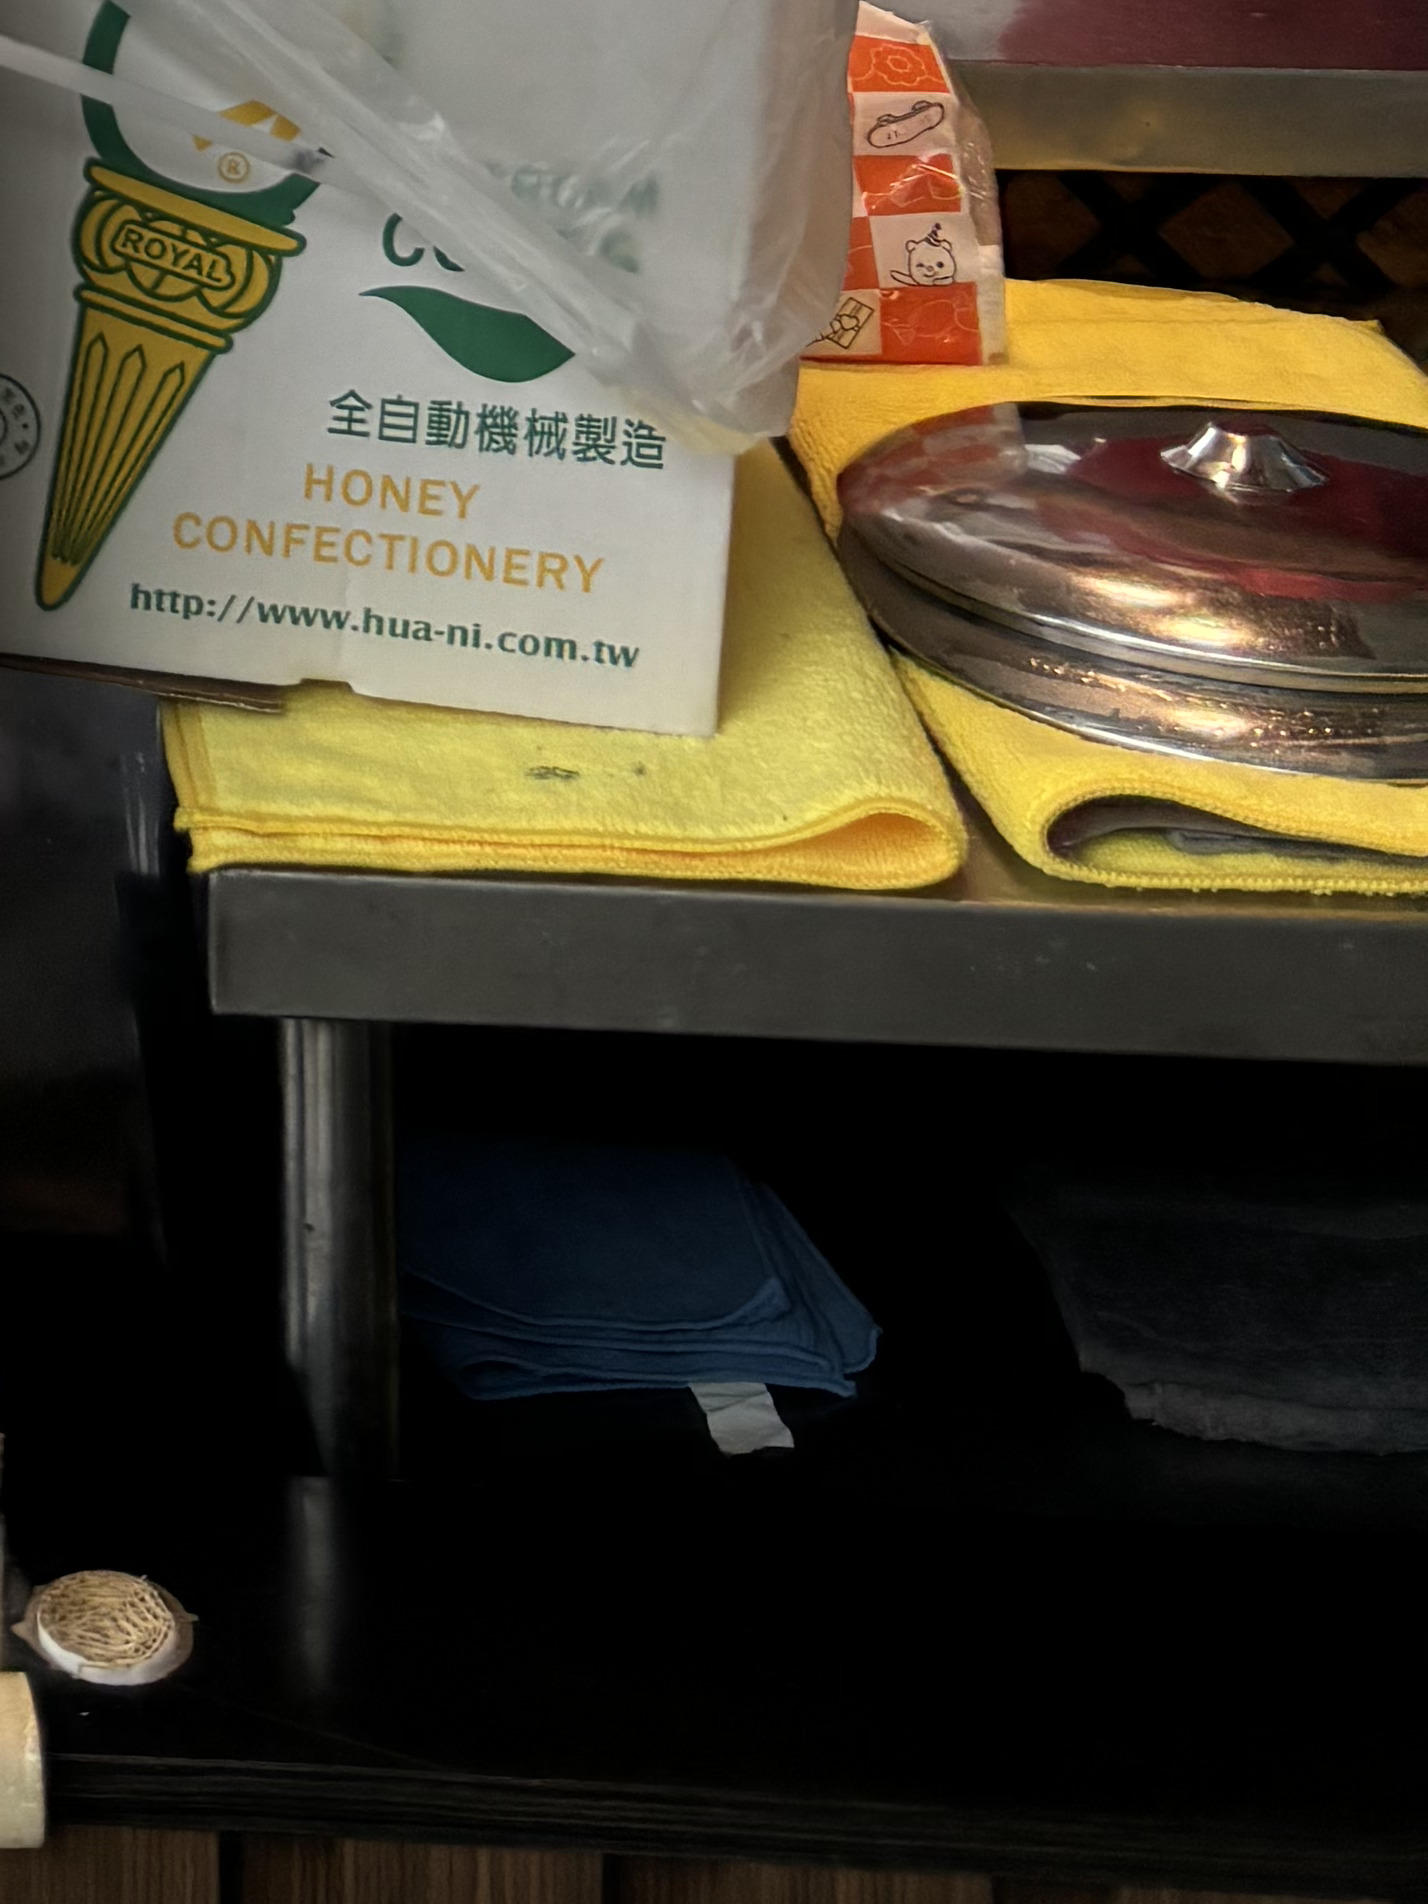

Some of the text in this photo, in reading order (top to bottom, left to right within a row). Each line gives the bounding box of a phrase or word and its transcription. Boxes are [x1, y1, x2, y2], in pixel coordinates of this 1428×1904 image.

[121, 228, 224, 284] ROYAL
[327, 389, 667, 470] 全自動機械製造
[303, 462, 481, 521] HONEY
[172, 511, 605, 594] CONFECTIONERY
[129, 582, 640, 670] http://www.hua-ni.com.tw
